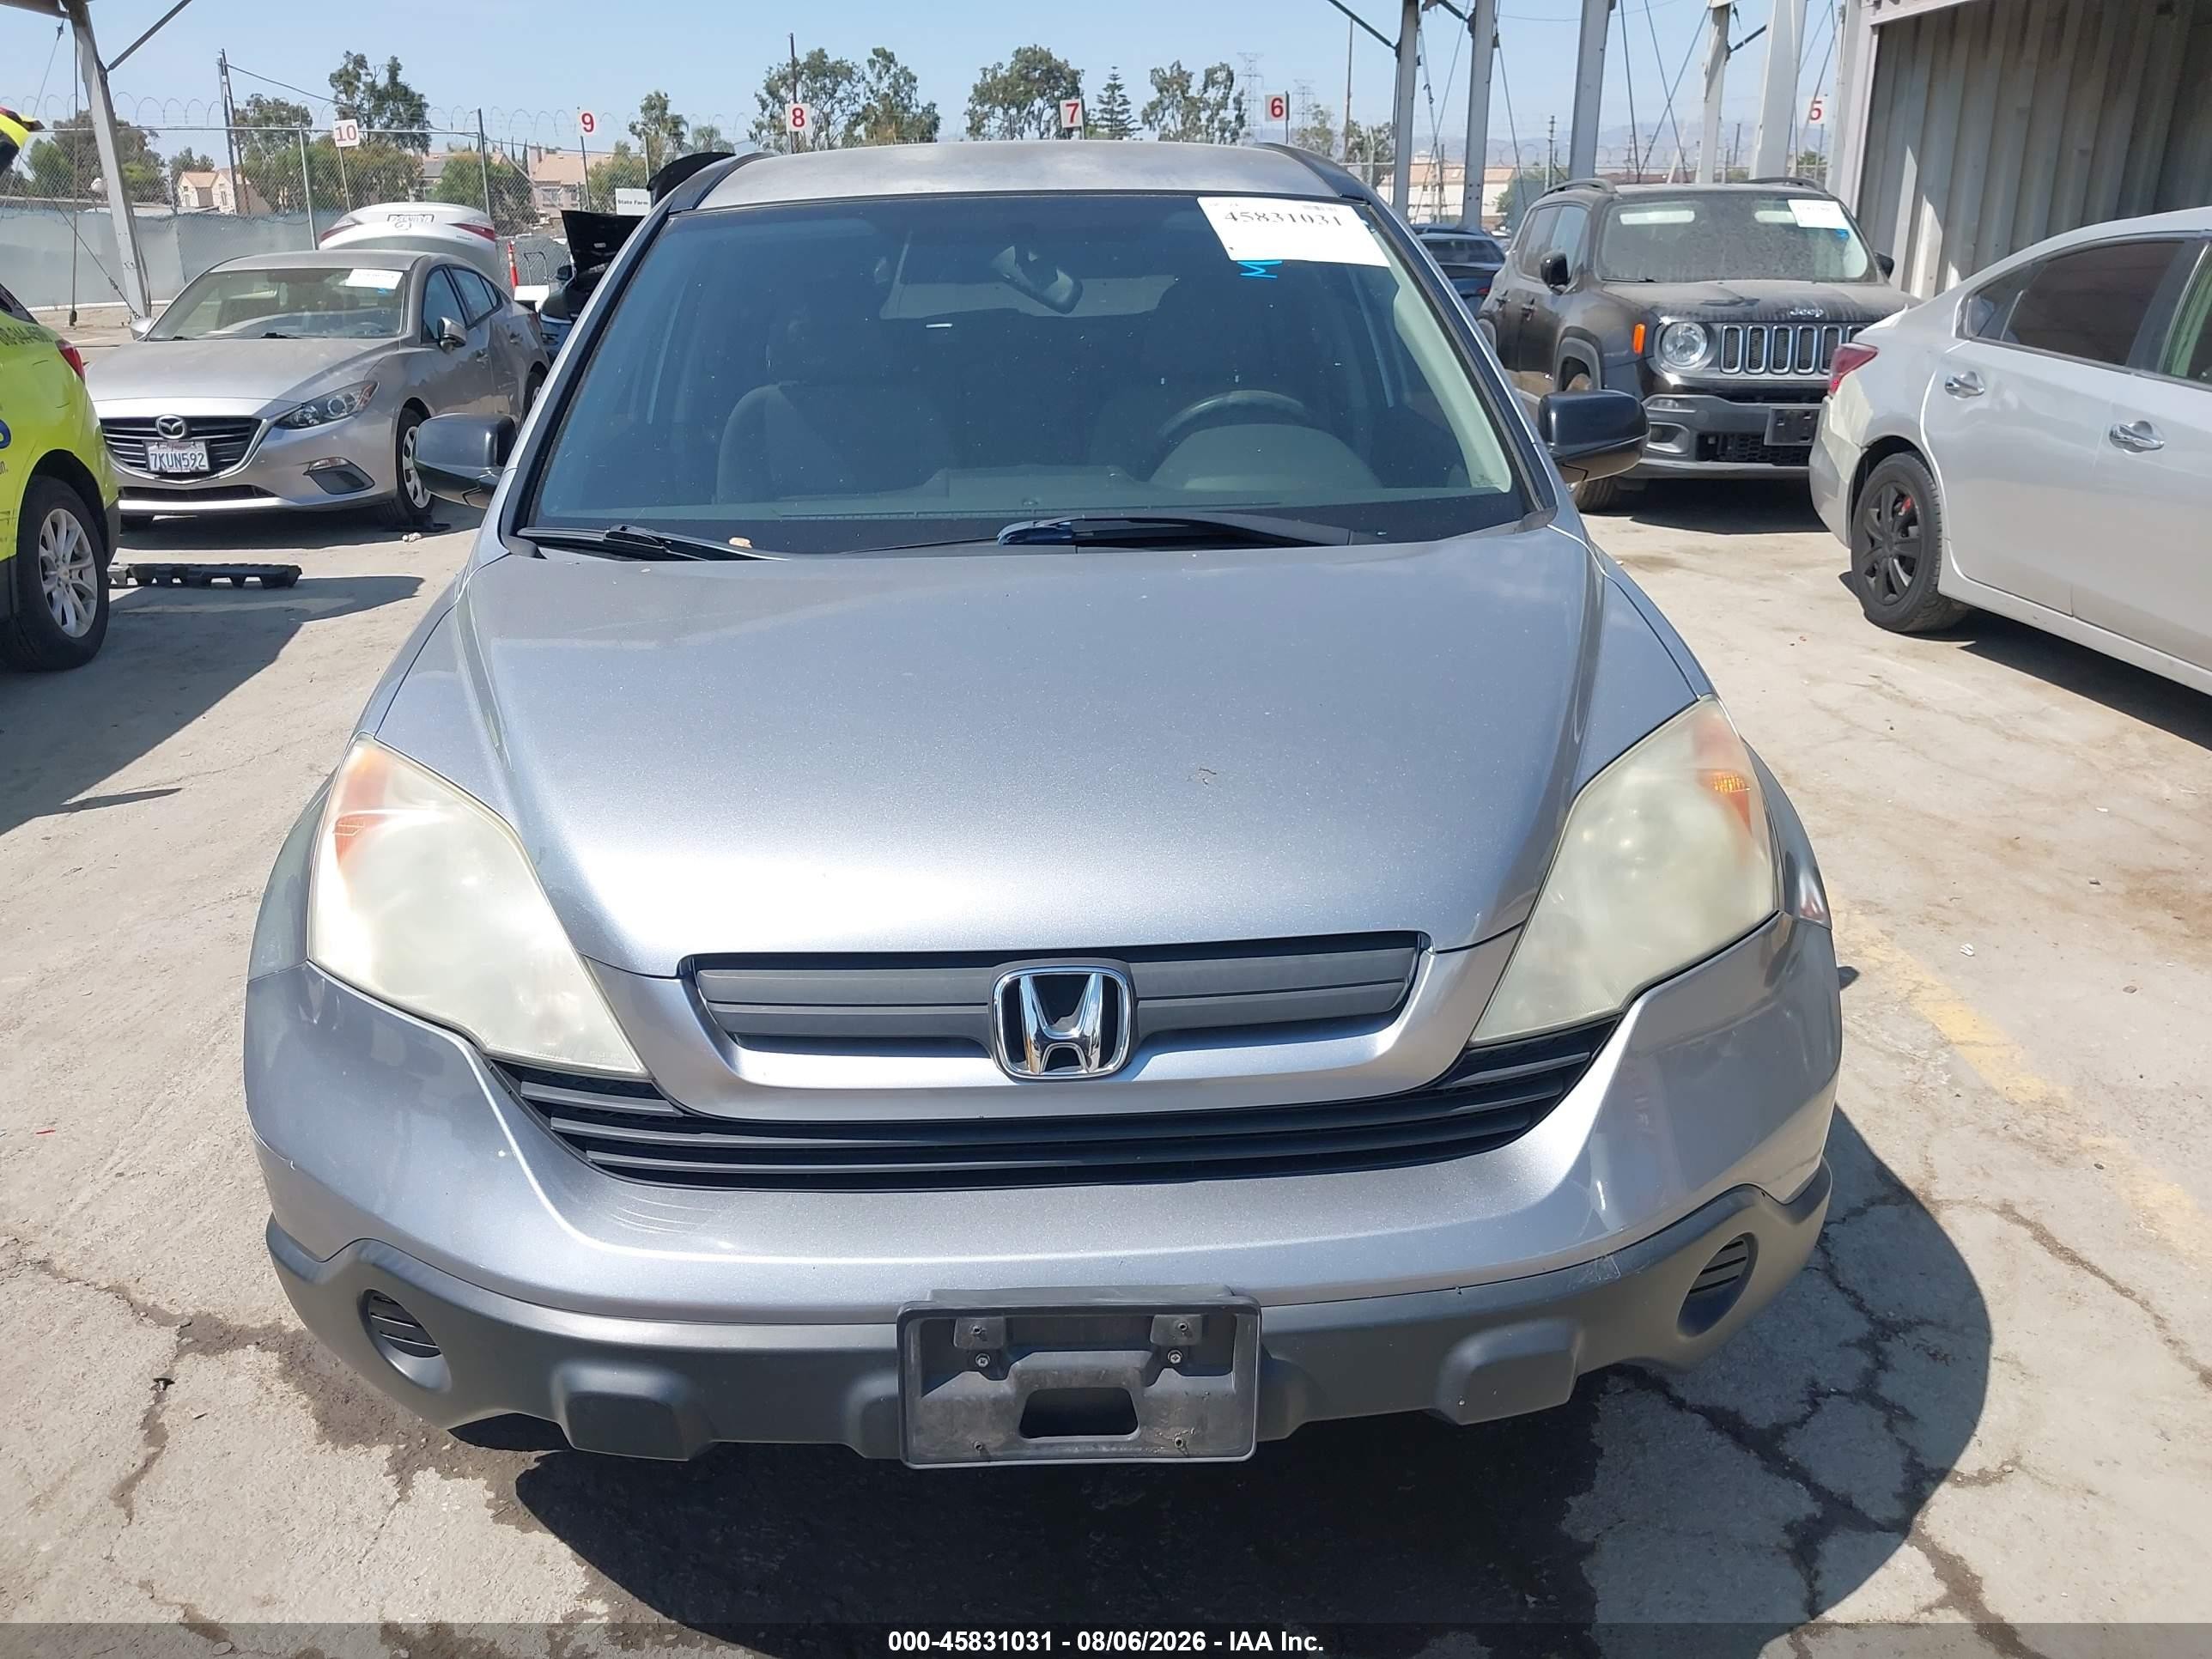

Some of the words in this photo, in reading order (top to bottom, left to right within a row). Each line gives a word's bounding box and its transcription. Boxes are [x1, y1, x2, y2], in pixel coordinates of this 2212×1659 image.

[792, 107, 805, 127] 8
[1066, 103, 1079, 124] 7
[1271, 97, 1284, 118] 6
[1809, 100, 1821, 120] 5
[581, 112, 594, 132] 9
[335, 125, 357, 142] 10
[1224, 211, 1342, 226] 45831031
[1790, 307, 1825, 318] Jeep
[149, 453, 207, 468] 7KUN592
